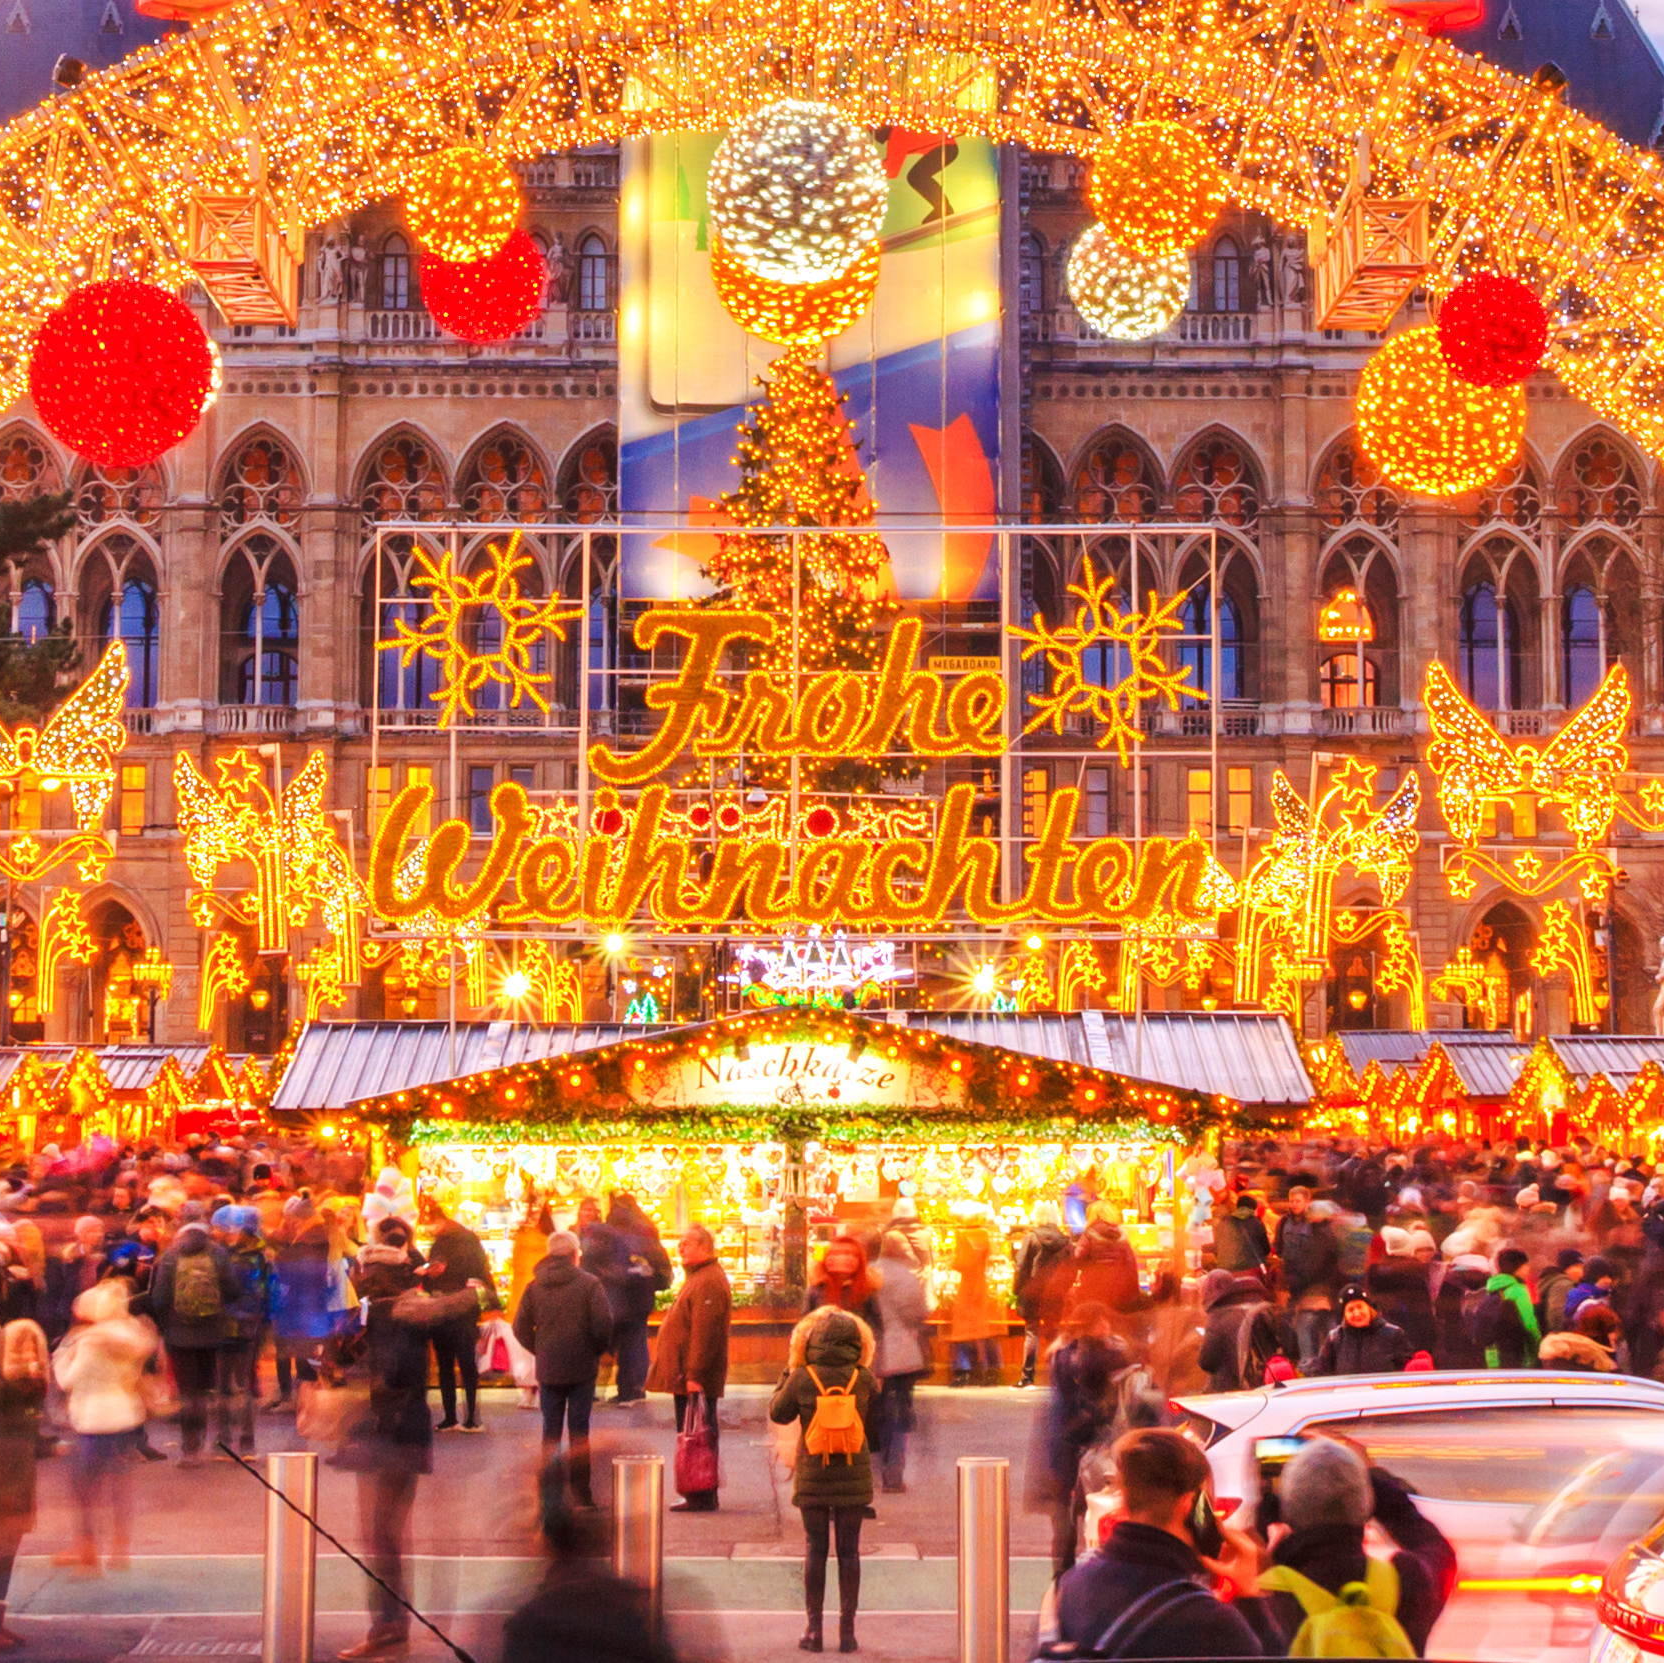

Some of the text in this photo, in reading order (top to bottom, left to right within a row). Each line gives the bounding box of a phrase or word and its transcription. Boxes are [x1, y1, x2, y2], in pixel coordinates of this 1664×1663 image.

[588, 609, 1007, 785] Frohe
[933, 659, 996, 670] MEGABOARD
[368, 781, 1211, 924] Weihnachten
